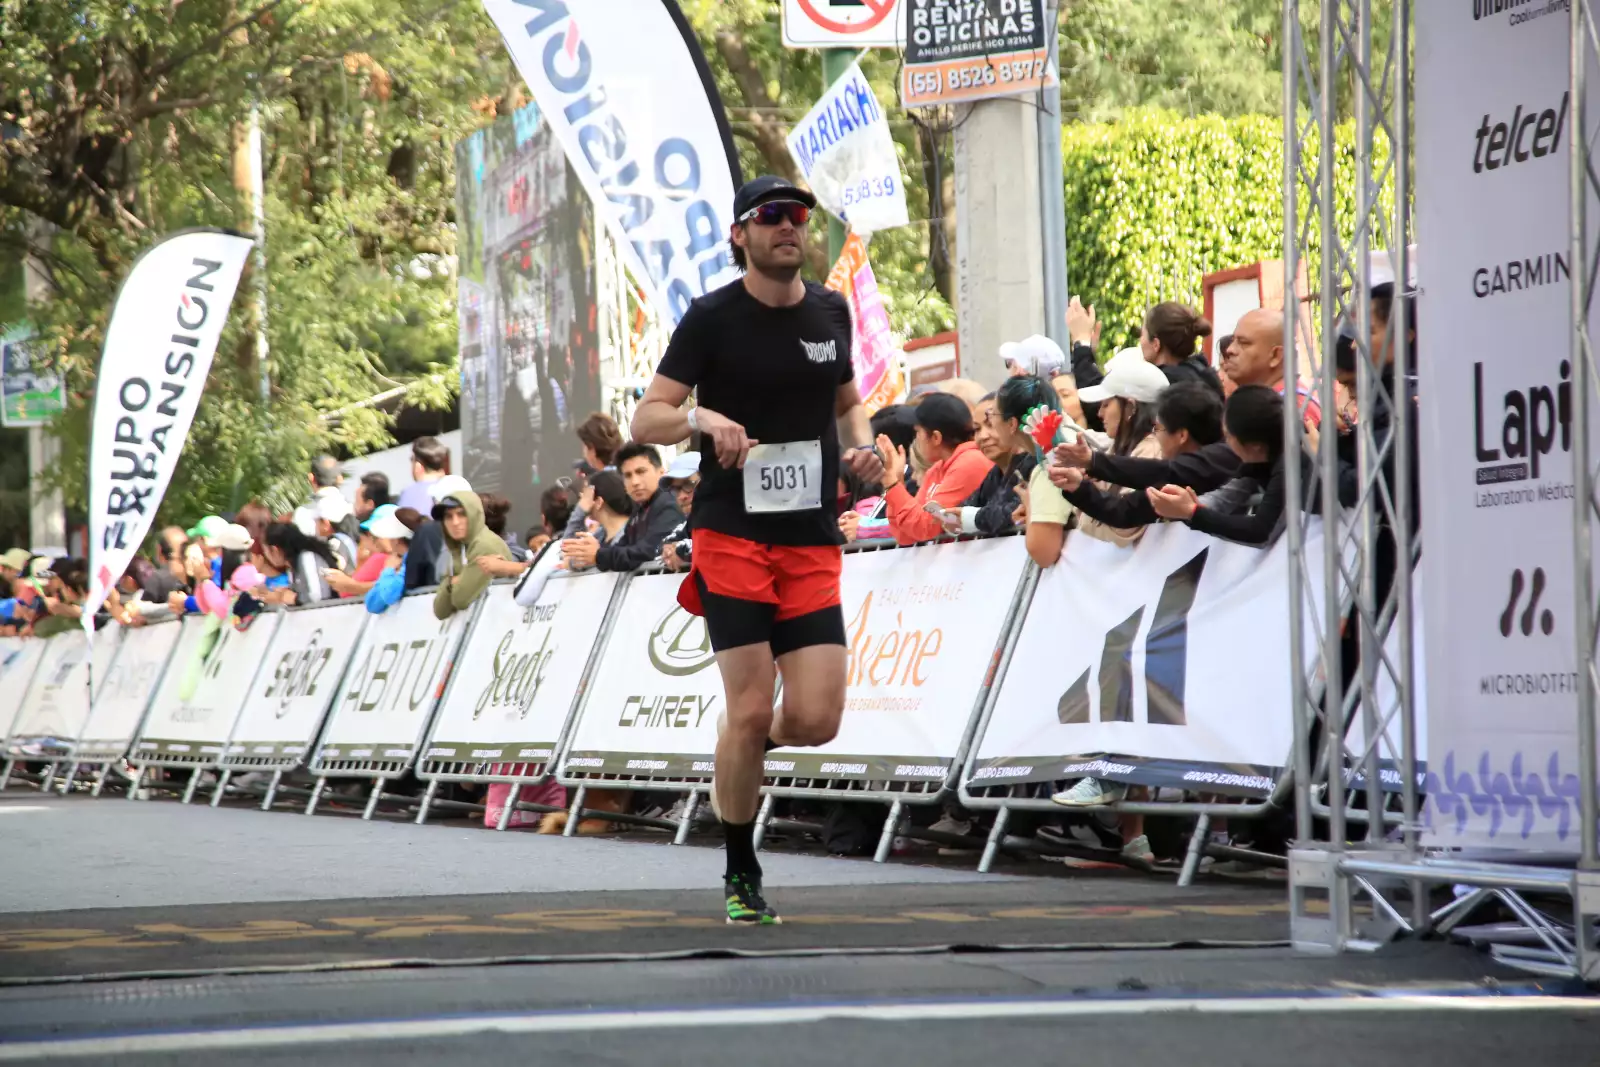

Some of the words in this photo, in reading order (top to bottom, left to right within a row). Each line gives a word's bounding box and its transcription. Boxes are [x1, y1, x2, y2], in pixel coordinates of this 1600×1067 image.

[913, 13, 1036, 46] OFICINAS
[914, 1, 990, 26] RENTA
[908, 68, 943, 97] (55)
[948, 64, 996, 90] 8526
[1473, 91, 1569, 174] telcel
[1472, 252, 1571, 298] GARMIN
[1474, 359, 1573, 479] Lapi
[760, 464, 808, 491] 5031
[1479, 671, 1580, 696] MICROBIOTFIT
[617, 694, 718, 729] CHIREY
